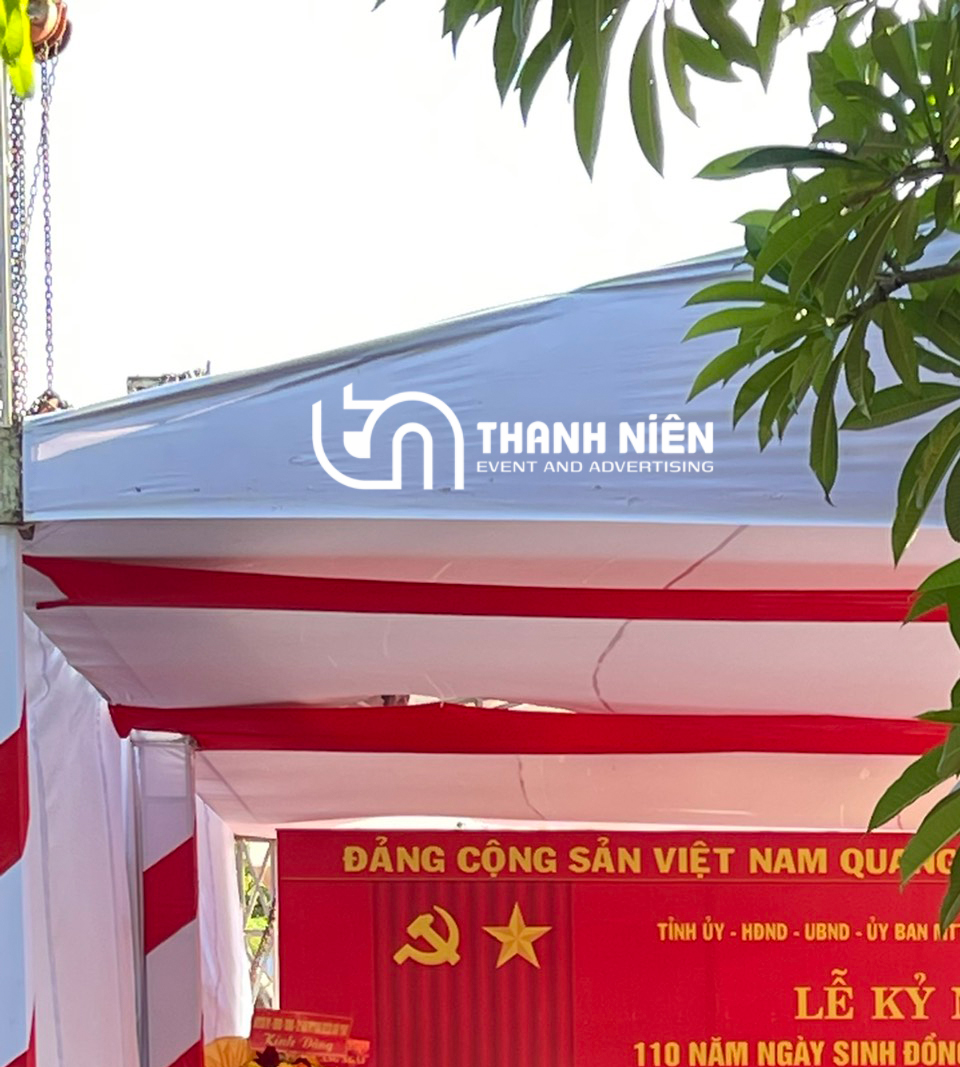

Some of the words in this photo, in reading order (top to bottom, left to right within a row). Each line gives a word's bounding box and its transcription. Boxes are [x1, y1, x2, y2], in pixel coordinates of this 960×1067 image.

[343, 836, 445, 873] ĐẢNG
[457, 839, 557, 878] CỘNG
[569, 836, 641, 873] SẢN
[653, 840, 736, 879] VIỆT
[749, 847, 827, 874] NAM
[657, 916, 697, 941] TỈNH
[702, 916, 725, 941] ỦY
[741, 922, 788, 941] HĐND
[804, 922, 850, 941] UBND
[866, 916, 889, 941] ỦY
[894, 922, 929, 941] BAN
[794, 968, 854, 1020] LỄ
[870, 972, 936, 1020] KỶ
[634, 1041, 680, 1067] 110
[688, 1036, 749, 1067] NĂM
[757, 1035, 825, 1067] NGÀY
[833, 1040, 896, 1067] SINH
